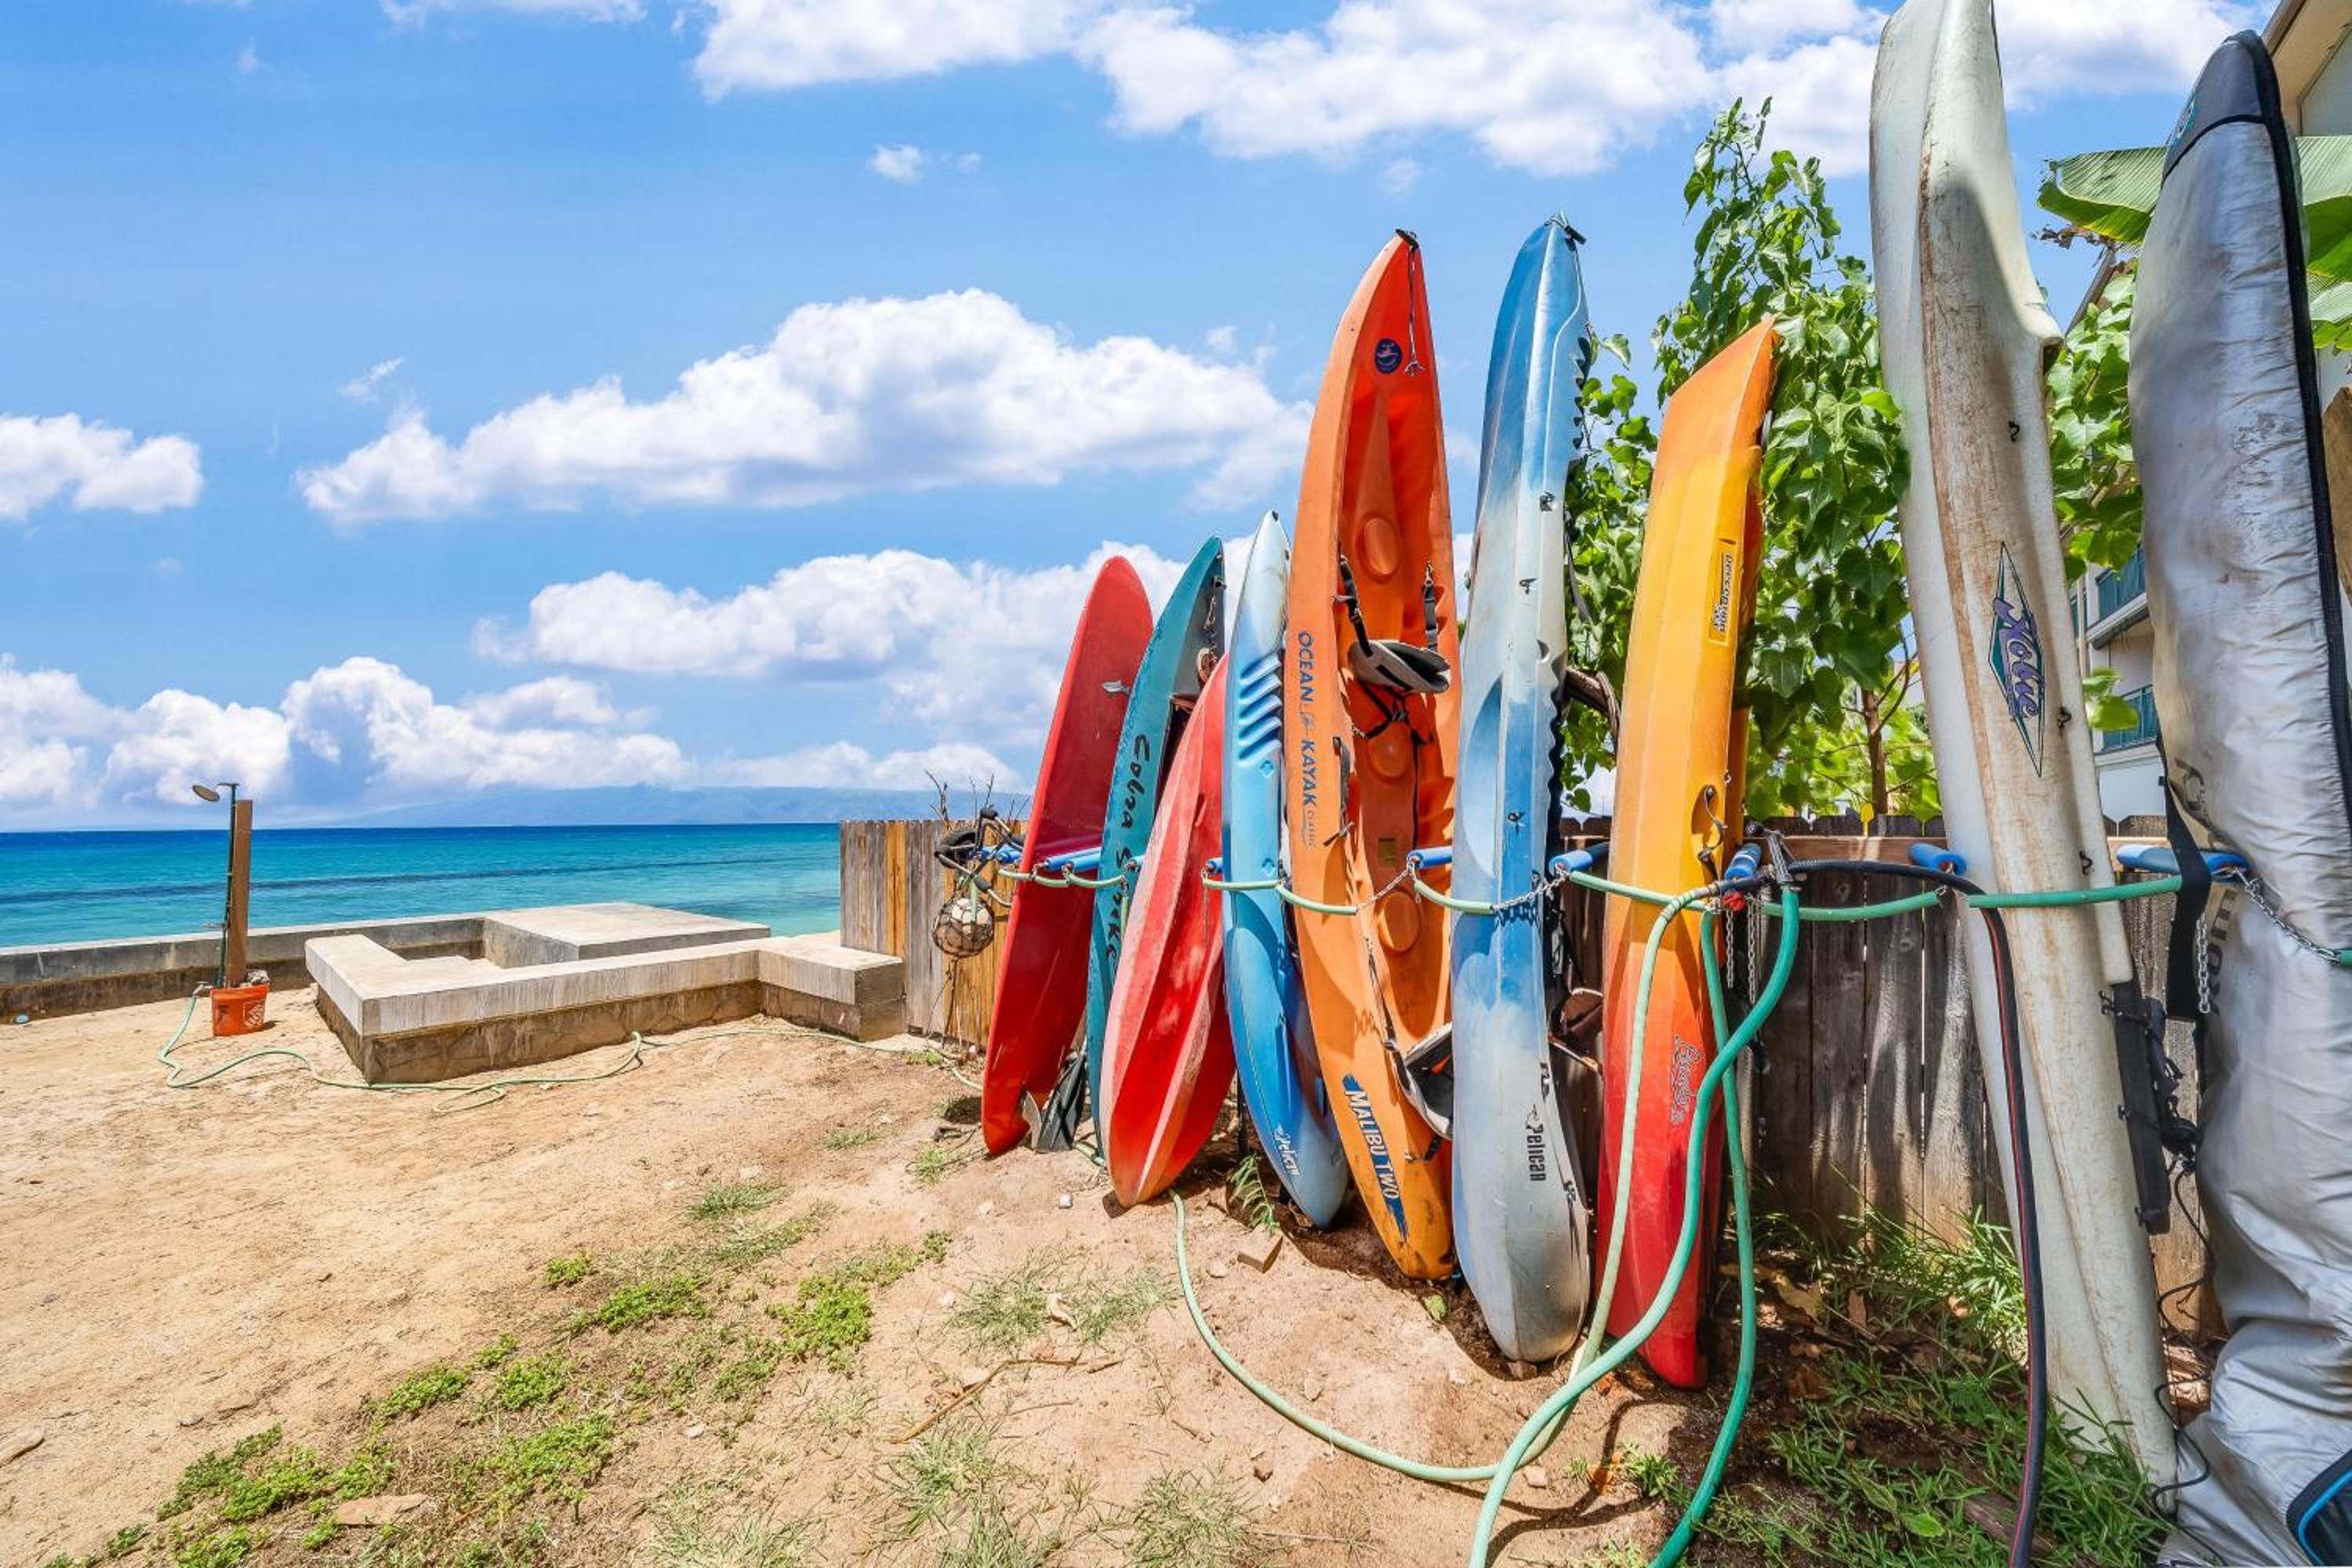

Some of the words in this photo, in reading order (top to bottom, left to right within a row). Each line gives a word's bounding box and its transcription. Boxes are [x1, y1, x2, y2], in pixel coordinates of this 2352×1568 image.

[1298, 630, 1314, 702] OCEAN
[1301, 739, 1317, 807] KAYAK
[1345, 1090, 1388, 1156] MALIBU
[1374, 1160, 1400, 1199] TWO
[1526, 1123, 1547, 1181] Pelican
